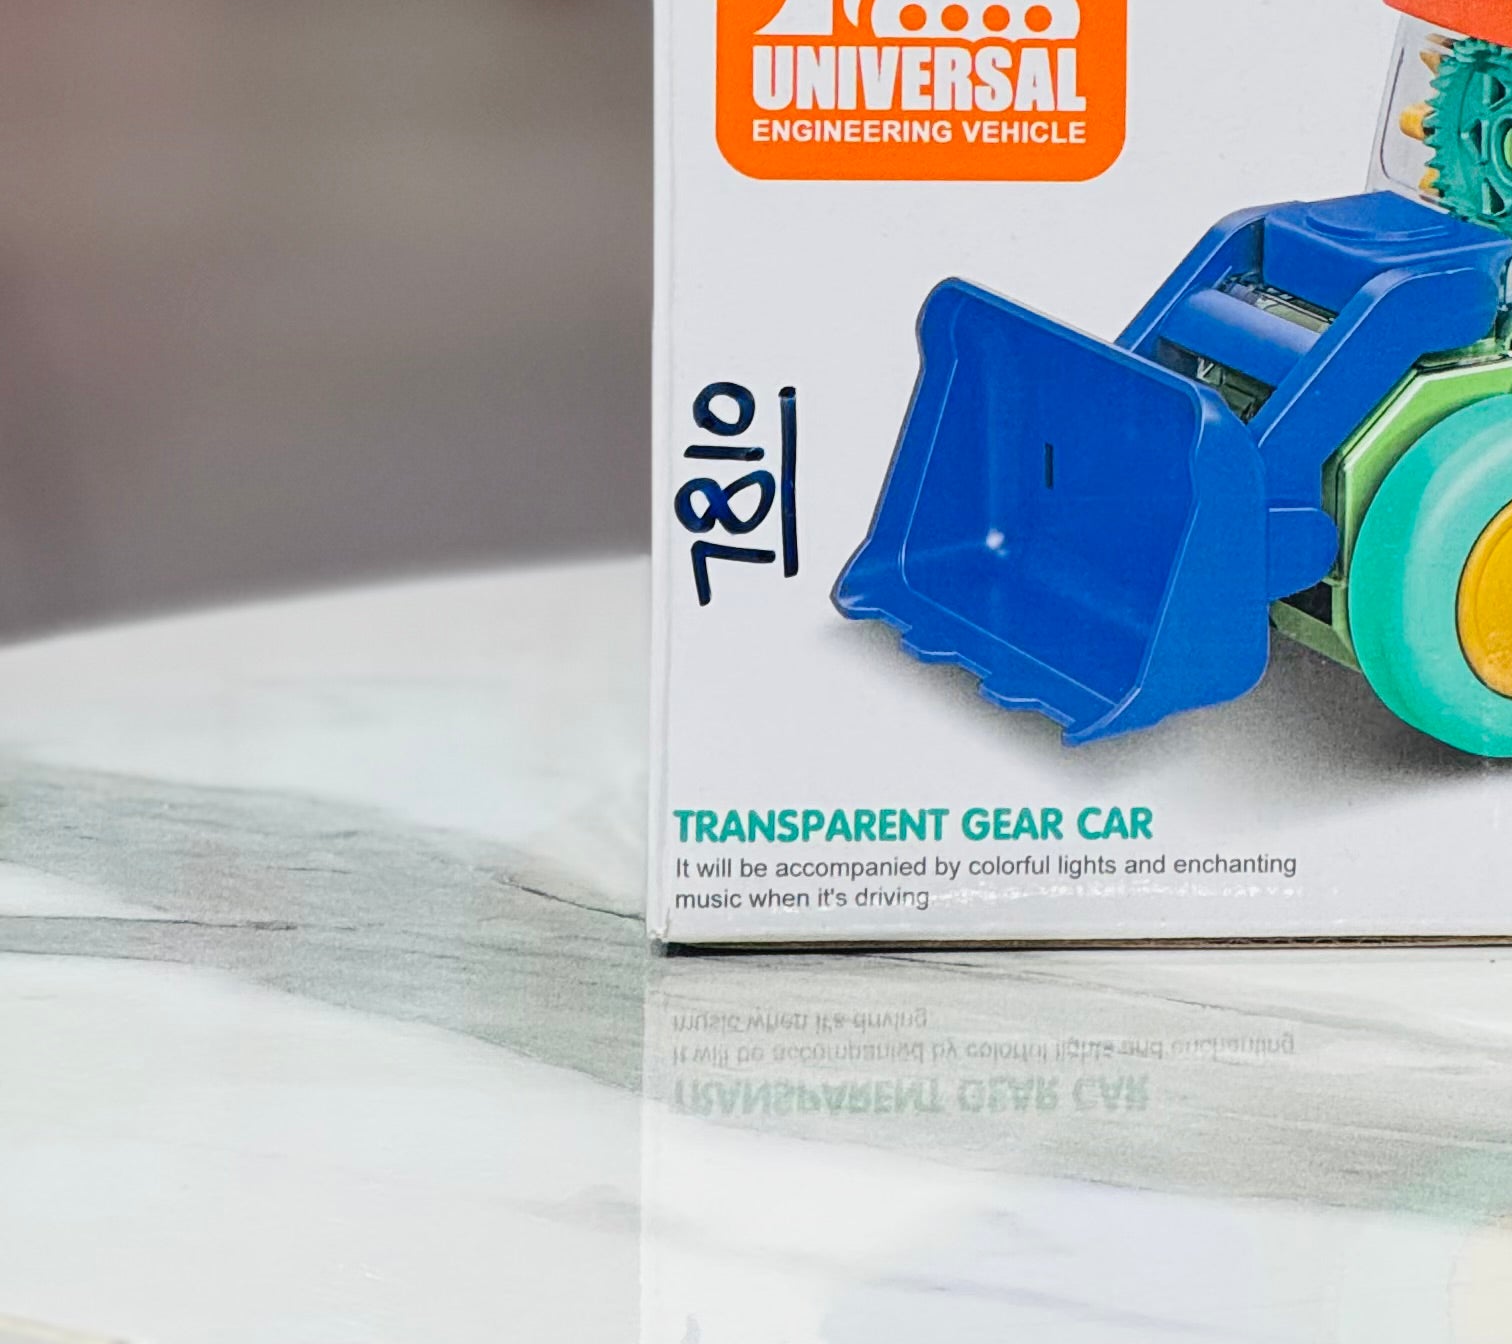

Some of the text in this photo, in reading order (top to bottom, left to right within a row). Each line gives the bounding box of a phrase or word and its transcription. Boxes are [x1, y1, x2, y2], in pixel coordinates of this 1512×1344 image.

[752, 46, 1087, 112] UNIVERSAL
[752, 119, 1087, 144] ENGINEERING VEHICLE
[674, 381, 777, 607] 7810
[673, 806, 1153, 843] TRANSPARENT GEAR CAR
[675, 853, 1297, 882] It will be accompanied by colorful lights and enchanting
[675, 887, 930, 910] music when it's driving
